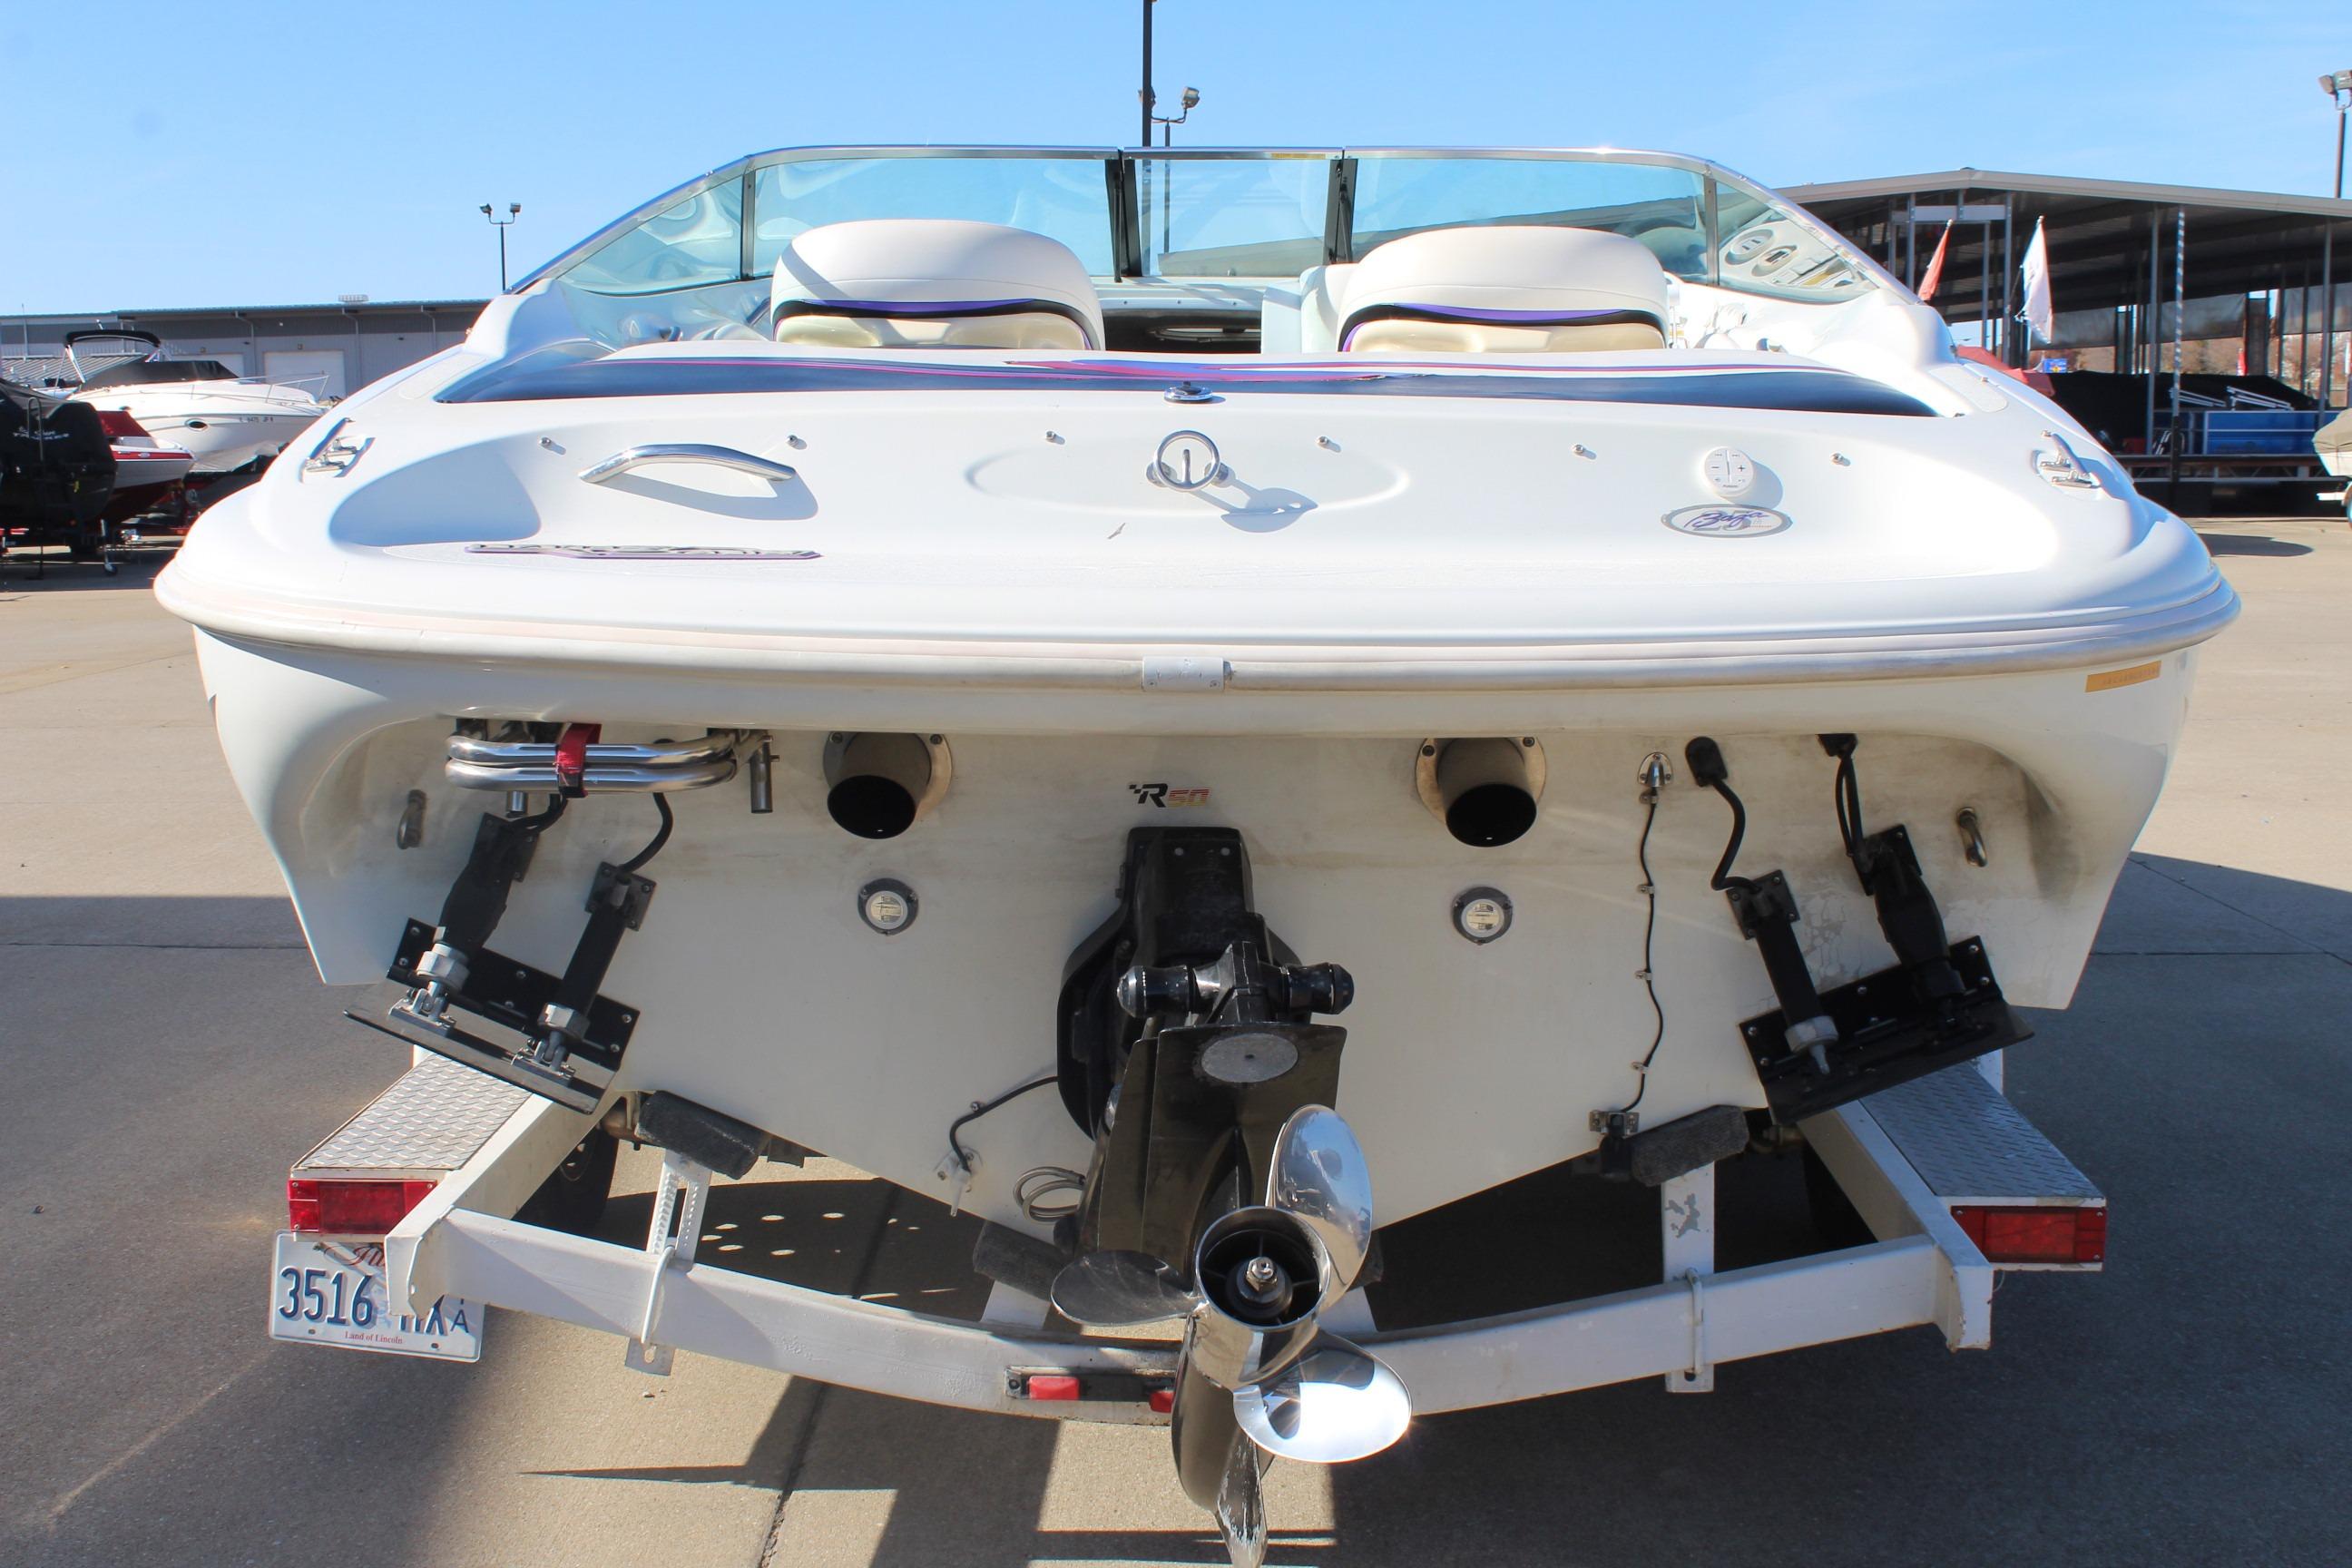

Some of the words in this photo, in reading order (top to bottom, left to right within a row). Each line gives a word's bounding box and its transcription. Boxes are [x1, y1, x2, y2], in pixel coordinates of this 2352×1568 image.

[1683, 510, 1769, 528] Baja
[279, 1267, 373, 1327] 3516
[345, 1331, 365, 1340] Land
[366, 1333, 374, 1341] of
[375, 1334, 403, 1344] Lincoln
